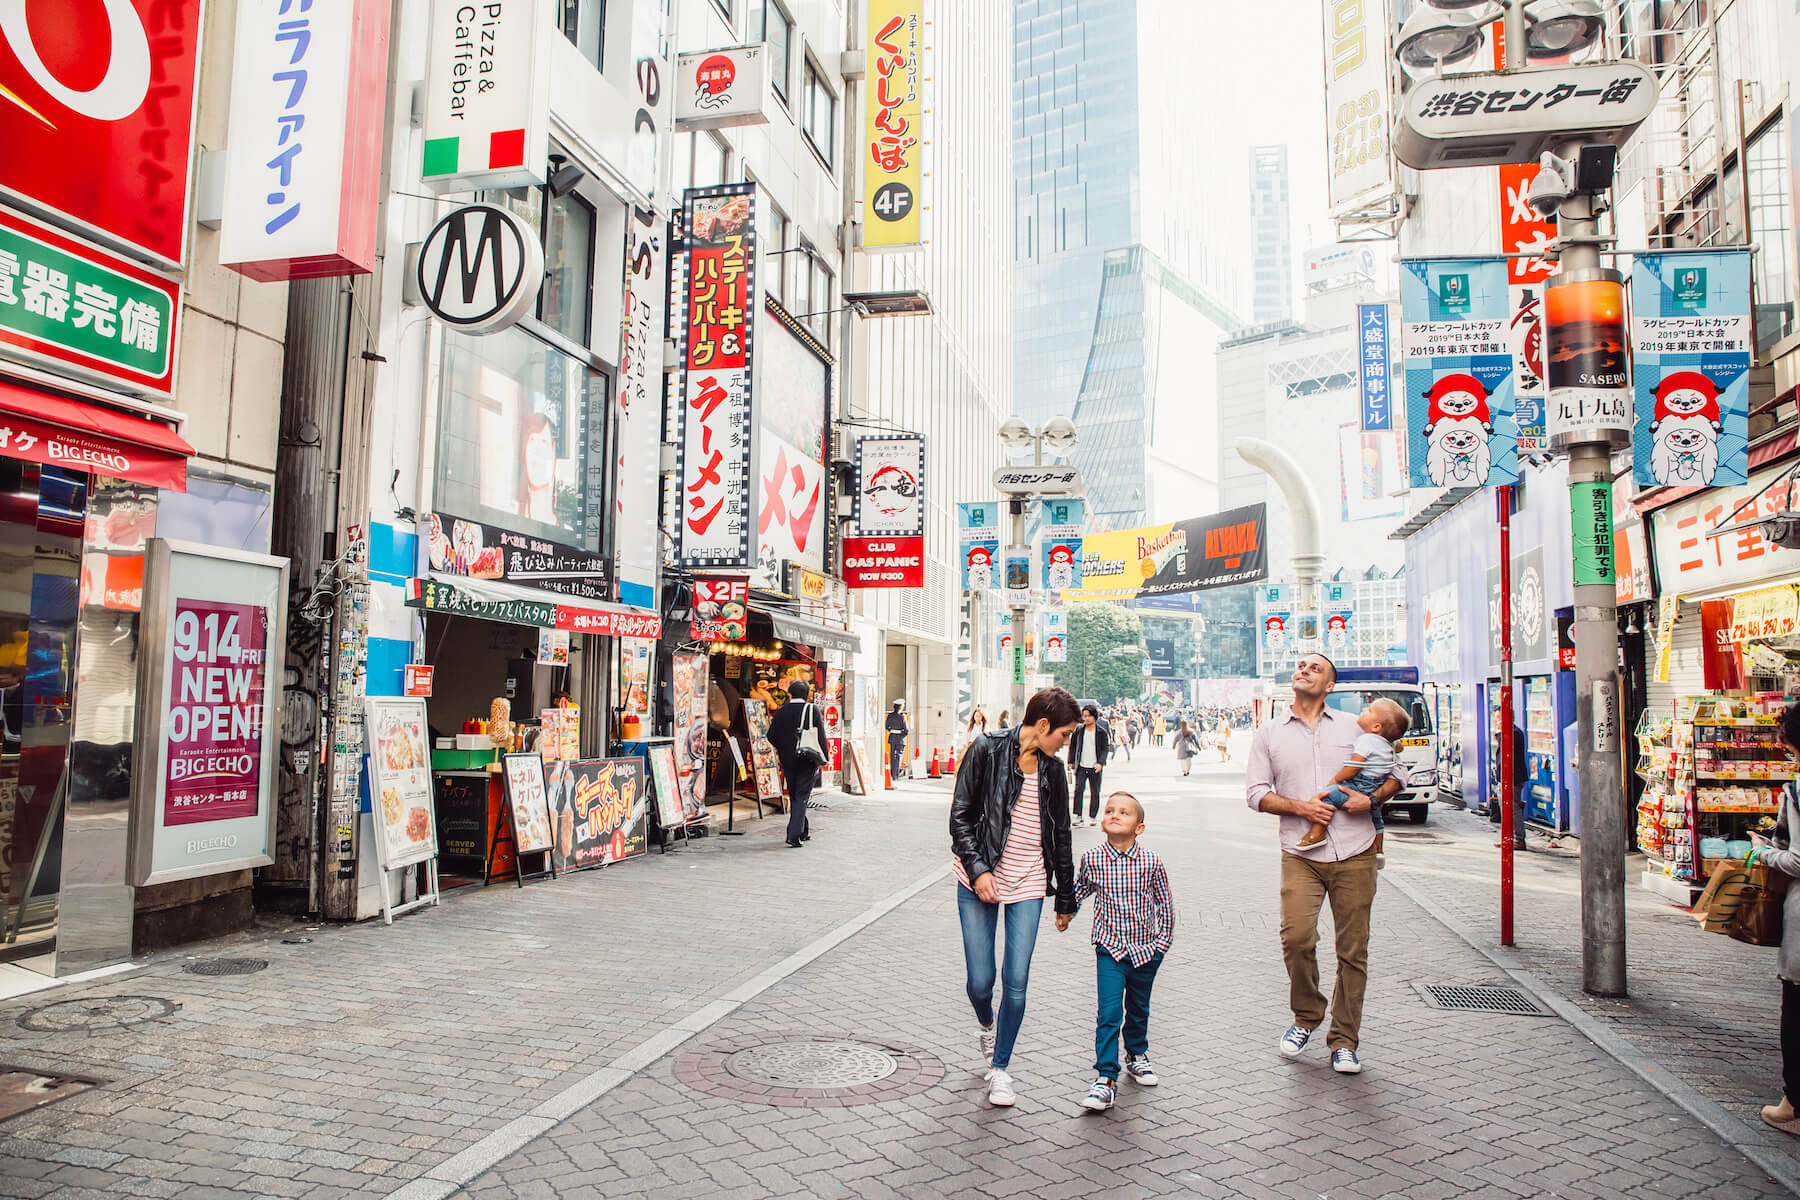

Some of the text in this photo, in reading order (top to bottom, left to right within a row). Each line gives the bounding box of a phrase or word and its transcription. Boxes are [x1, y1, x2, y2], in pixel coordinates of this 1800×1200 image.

[478, 3, 502, 94] Pizza &
[745, 51, 759, 59] 3F
[871, 15, 916, 173] くいしんぼ
[1418, 77, 1642, 118] 渋谷センター街
[874, 190, 909, 214] 4F
[692, 257, 721, 366] ハンバーグ
[1642, 318, 1740, 328] ラグビーワールドカップ
[1411, 321, 1503, 333] ラグビーワールドカップ
[1363, 311, 1387, 426] 大盛堂商事ビル
[1578, 372, 1627, 385] SASEBO
[47, 440, 130, 472] BIG ECHO
[687, 374, 729, 537] ラーメン
[726, 373, 744, 536] 元祖博多 中洲屋台
[999, 471, 1077, 484] 渋谷センター街
[1592, 487, 1612, 578] 客引きは犯罪です
[687, 547, 741, 559] ICHIRYU
[845, 556, 920, 568] GAS PANIC
[868, 543, 896, 552] CLUB
[715, 581, 747, 601] 2F
[859, 572, 880, 581] NOW
[174, 610, 262, 665] 9.14 FRI
[180, 666, 254, 704] NEW
[168, 703, 261, 743] OPEN!
[170, 754, 254, 781] BIG ECHO
[173, 789, 248, 808] 渋谷センター街本店
[575, 760, 615, 820] チーズ
[589, 778, 636, 840] ハットグ
[186, 833, 239, 855] BIG ECHO
